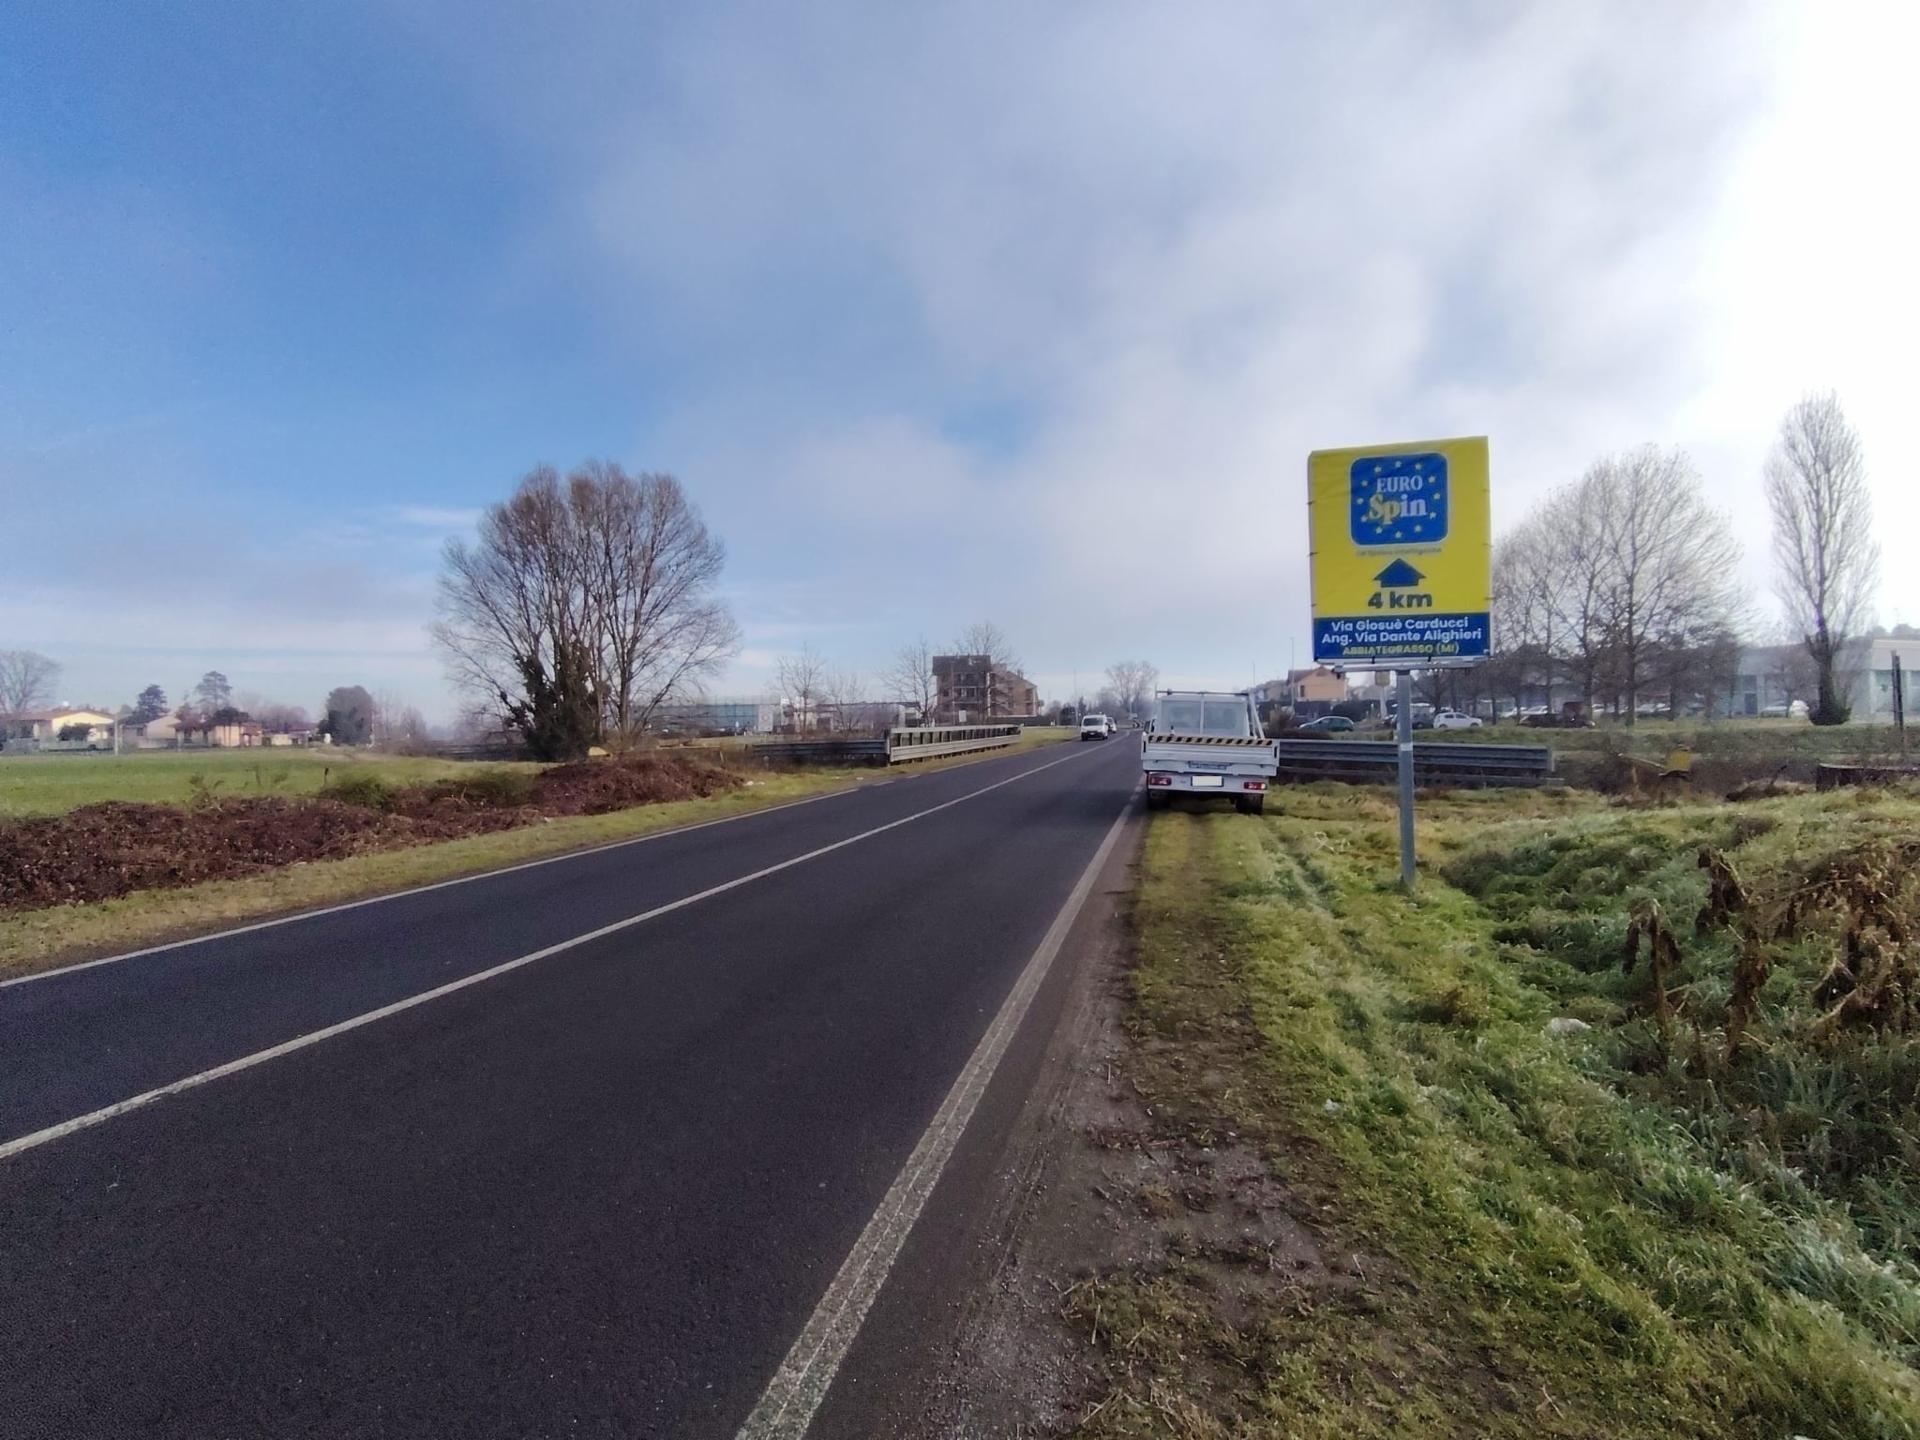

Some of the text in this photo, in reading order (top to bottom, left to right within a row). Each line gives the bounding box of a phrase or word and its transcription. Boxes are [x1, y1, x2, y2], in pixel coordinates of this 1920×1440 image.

[1376, 475, 1423, 493] EURO
[1366, 492, 1428, 525] Spin
[1367, 591, 1433, 609] 4 km
[1331, 616, 1469, 632] Via Giosuè Carducci
[1321, 628, 1482, 645] Ang. Via Dante Alighieri
[1342, 642, 1460, 655] ABBIATEGRASSO (MI)
